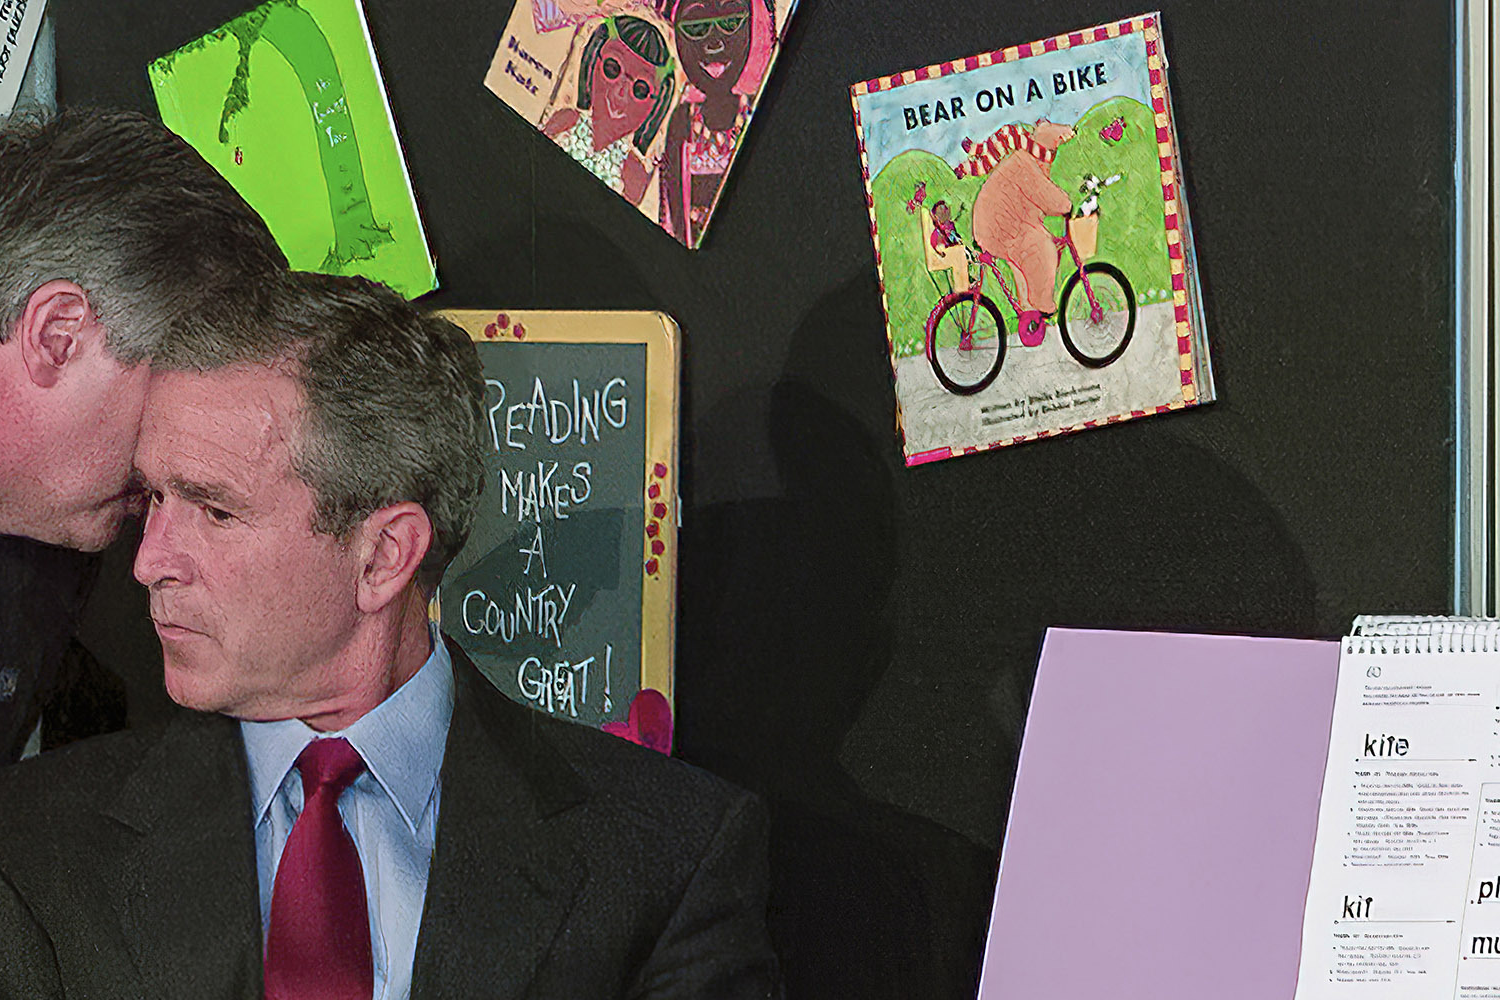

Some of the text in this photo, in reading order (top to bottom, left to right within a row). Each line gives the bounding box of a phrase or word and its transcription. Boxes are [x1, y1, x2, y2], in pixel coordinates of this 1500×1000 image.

[902, 62, 1109, 132] BEAR ON A BIKE
[485, 376, 629, 452] READING
[501, 460, 593, 524] MAKES
[518, 526, 548, 579] A
[461, 582, 577, 649] COUNTRY
[1363, 733, 1410, 758] kite
[1342, 894, 1374, 920] kit
